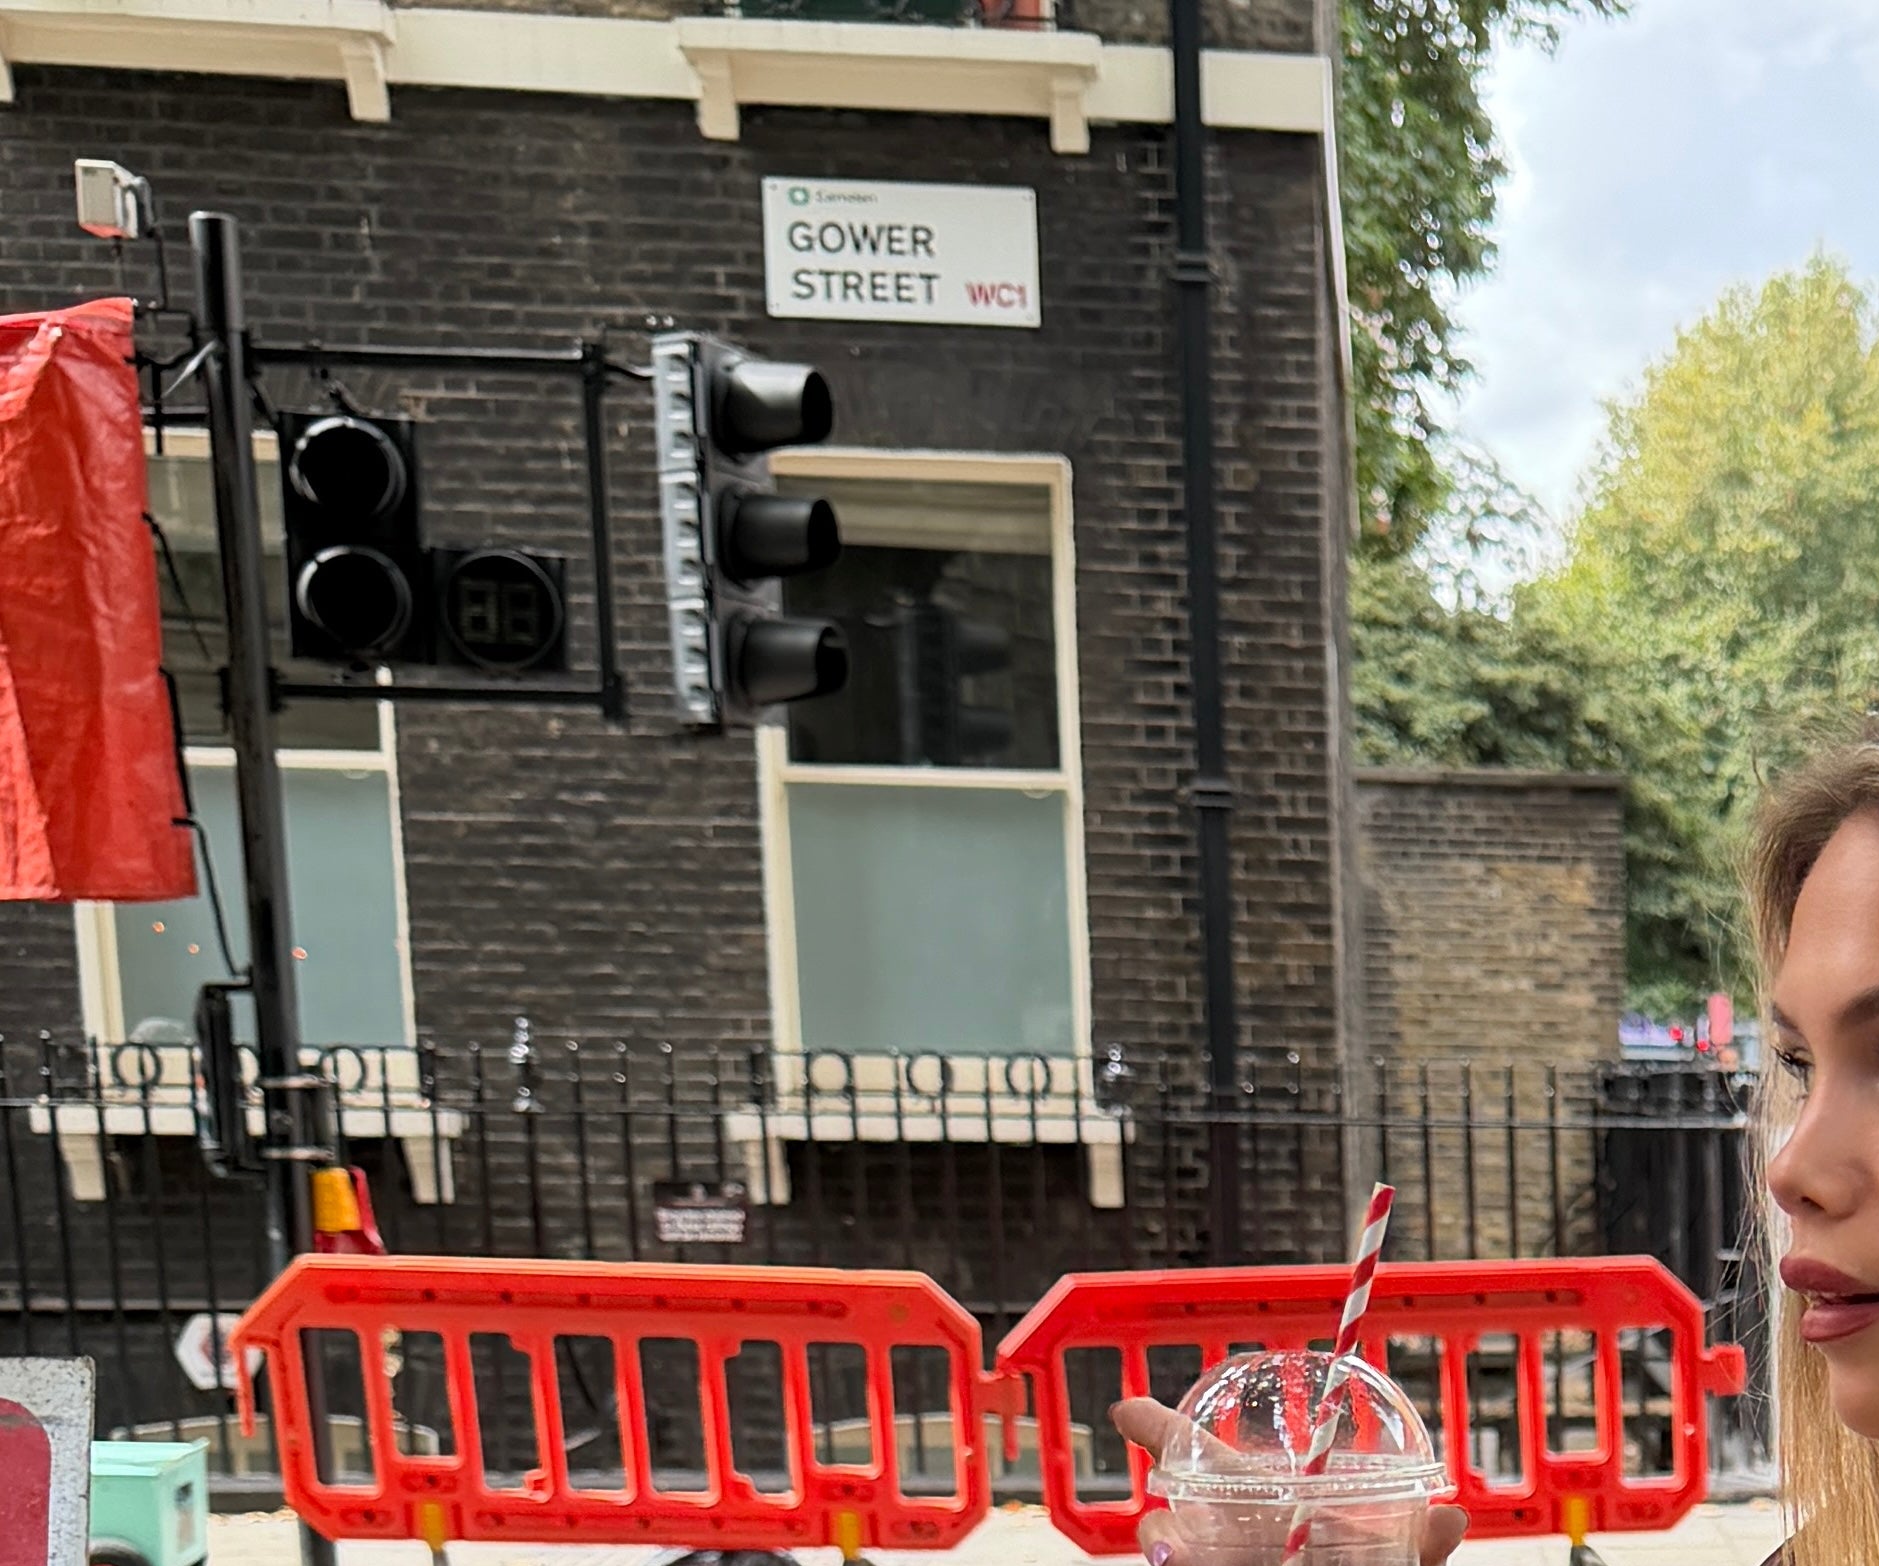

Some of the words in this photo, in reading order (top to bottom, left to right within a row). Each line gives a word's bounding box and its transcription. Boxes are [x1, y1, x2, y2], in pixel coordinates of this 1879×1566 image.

[788, 221, 935, 257] GOWER
[792, 269, 941, 304] STREET
[965, 281, 1028, 309] WC1
